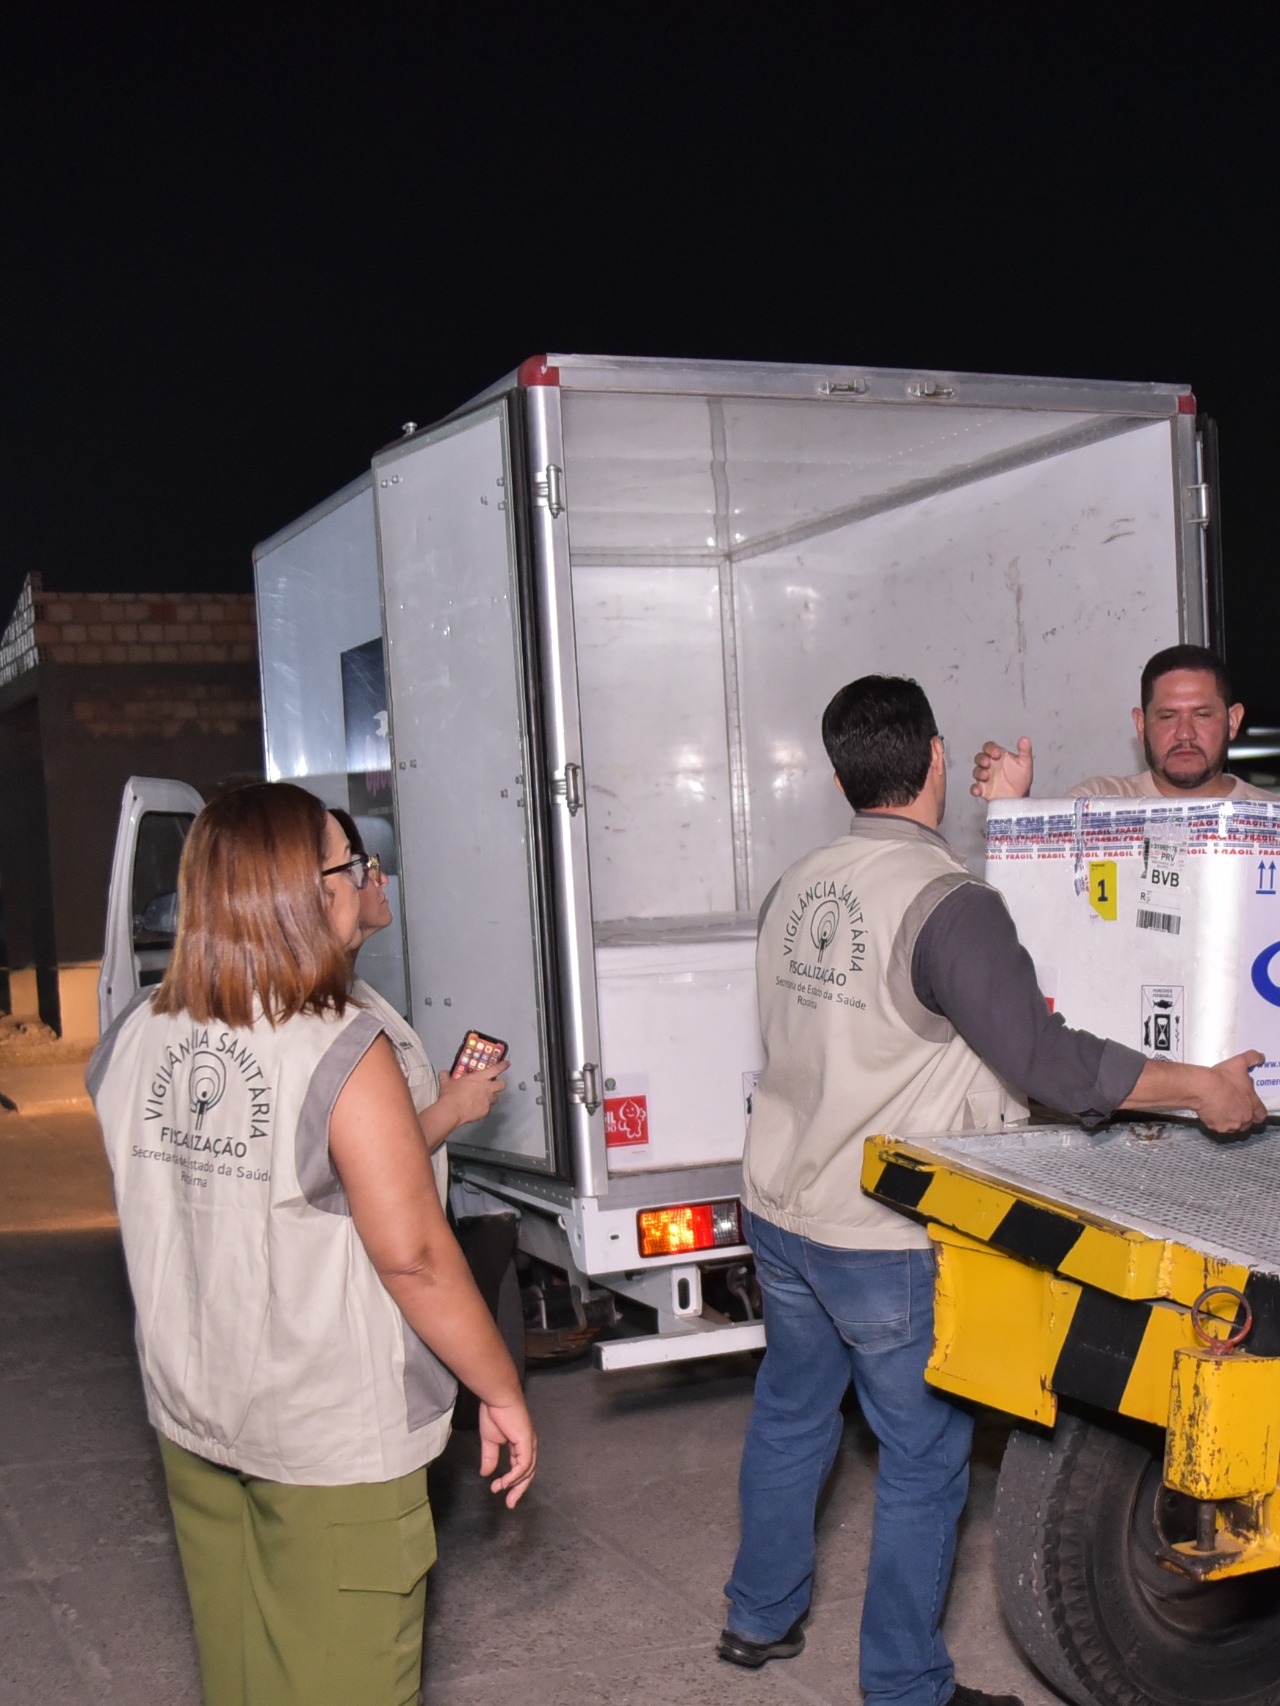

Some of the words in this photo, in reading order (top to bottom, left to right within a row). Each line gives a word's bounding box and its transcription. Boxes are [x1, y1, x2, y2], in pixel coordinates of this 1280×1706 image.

[1006, 850, 1033, 860] FRÁGIL
[1037, 850, 1066, 860] FRÁGIL
[1103, 848, 1134, 858] FRÁGIL
[1161, 852, 1176, 862] PRV
[1097, 878, 1108, 902] 1
[1151, 869, 1180, 888] BVB
[1140, 891, 1146, 902] R
[783, 880, 837, 956] VIGILÂNCIA
[838, 883, 869, 973] SANITÁRIA
[788, 959, 847, 987] FISCALIZAÇÃO
[797, 982, 806, 993] de
[823, 989, 833, 1000] da
[836, 992, 867, 1011] Saúde
[215, 1032, 272, 1139] SANITÁRIA
[160, 1125, 248, 1158] FICAIZAÇÃO
[217, 1163, 232, 1176] da
